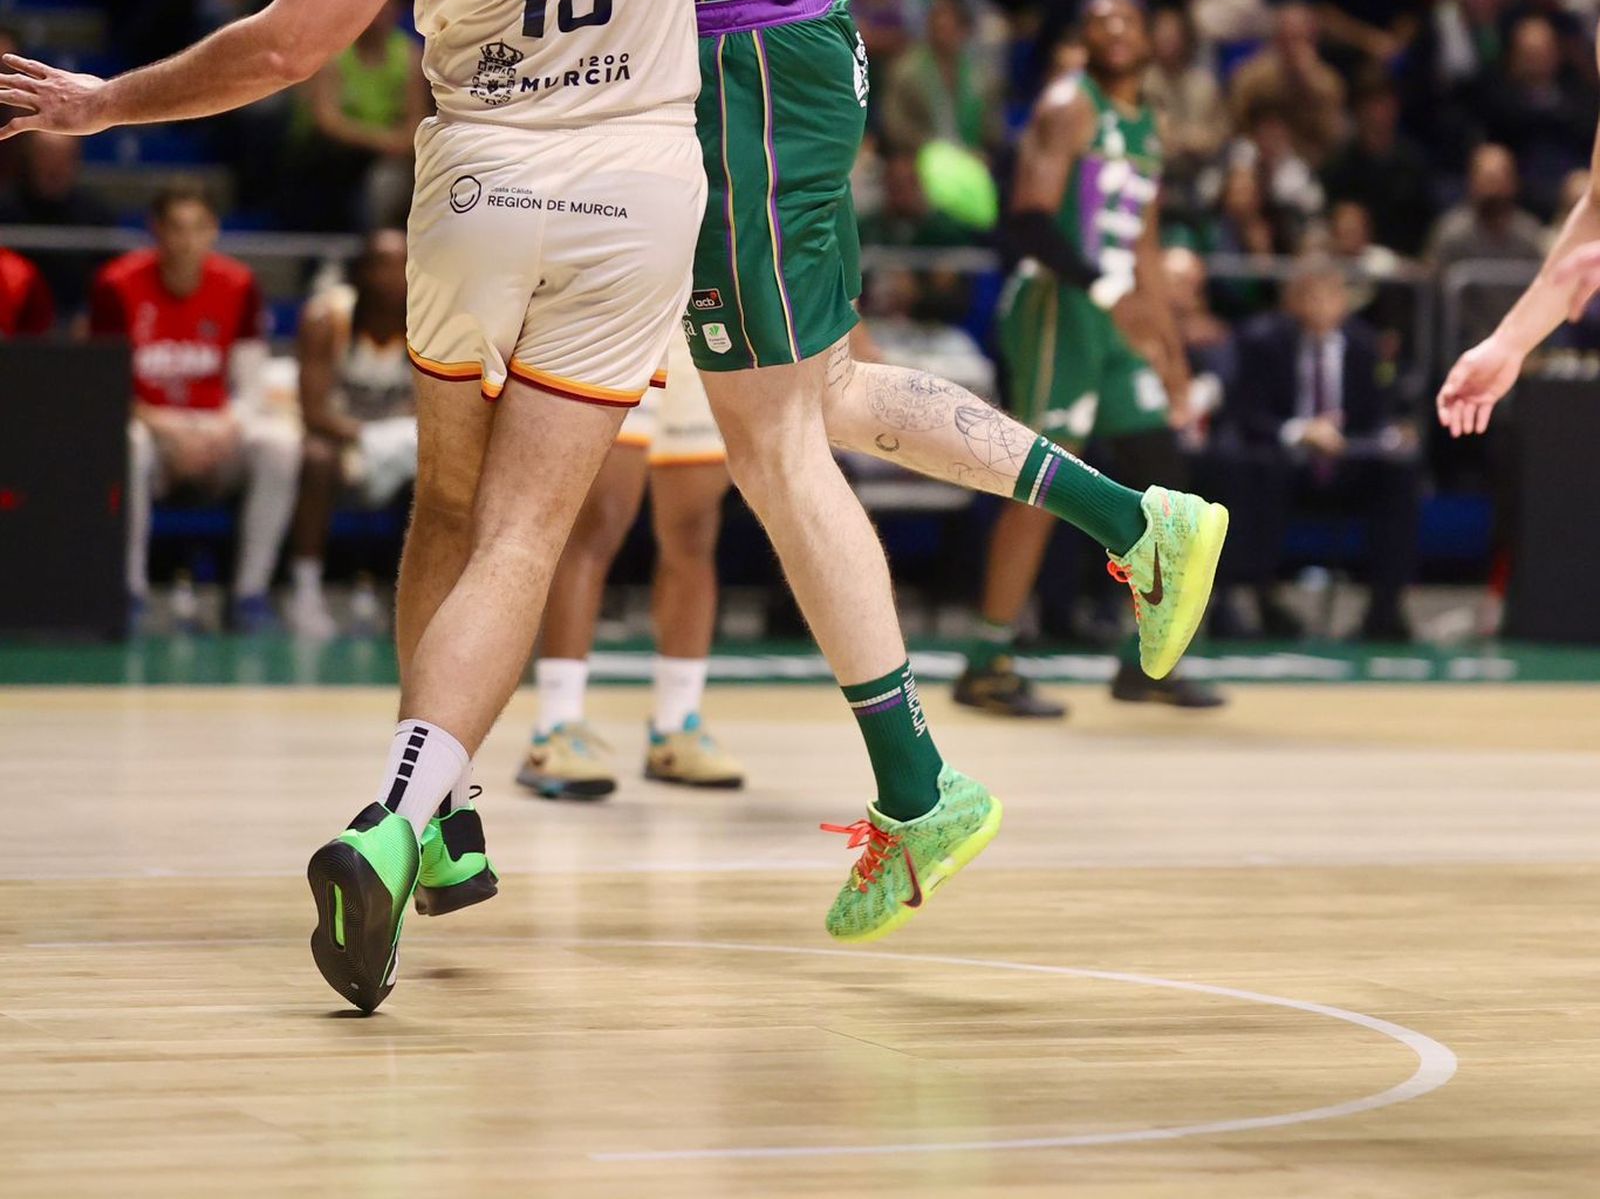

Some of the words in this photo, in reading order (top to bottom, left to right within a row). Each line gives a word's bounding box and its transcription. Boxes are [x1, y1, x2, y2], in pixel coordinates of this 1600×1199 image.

[579, 53, 629, 67] 1200
[520, 65, 630, 93] MURCIA
[546, 200, 565, 212] DE
[569, 201, 628, 219] MURCIA
[695, 297, 715, 307] acb
